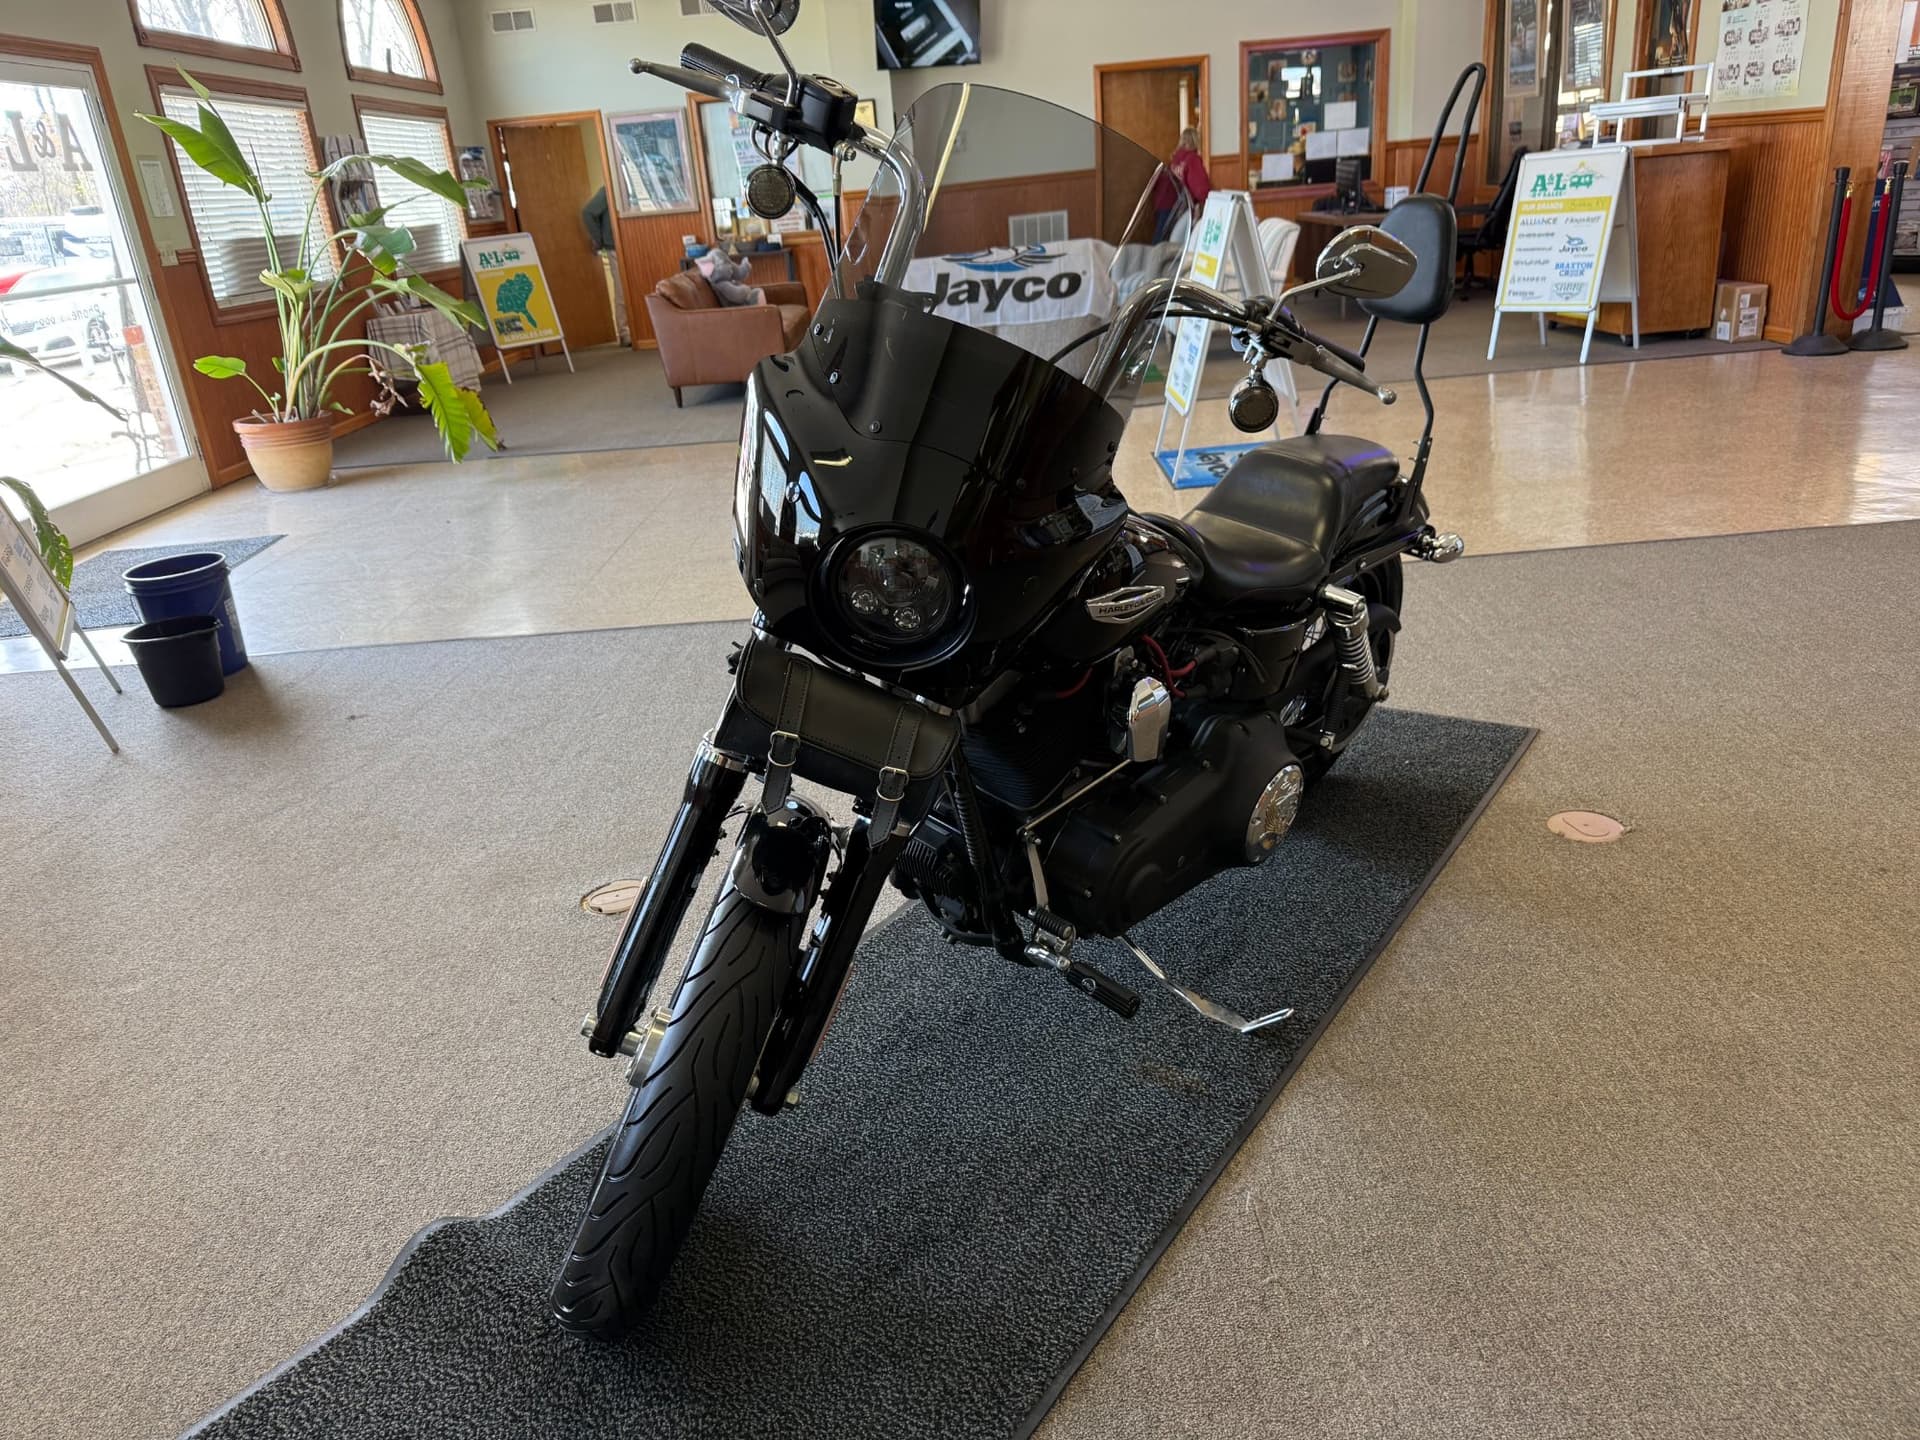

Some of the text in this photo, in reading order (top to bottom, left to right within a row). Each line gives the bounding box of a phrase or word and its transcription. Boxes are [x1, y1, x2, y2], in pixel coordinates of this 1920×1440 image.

[1558, 245, 1588, 254] Jayco
[1555, 262, 1593, 270] BRAXTON
[931, 271, 1082, 314] Jayco
